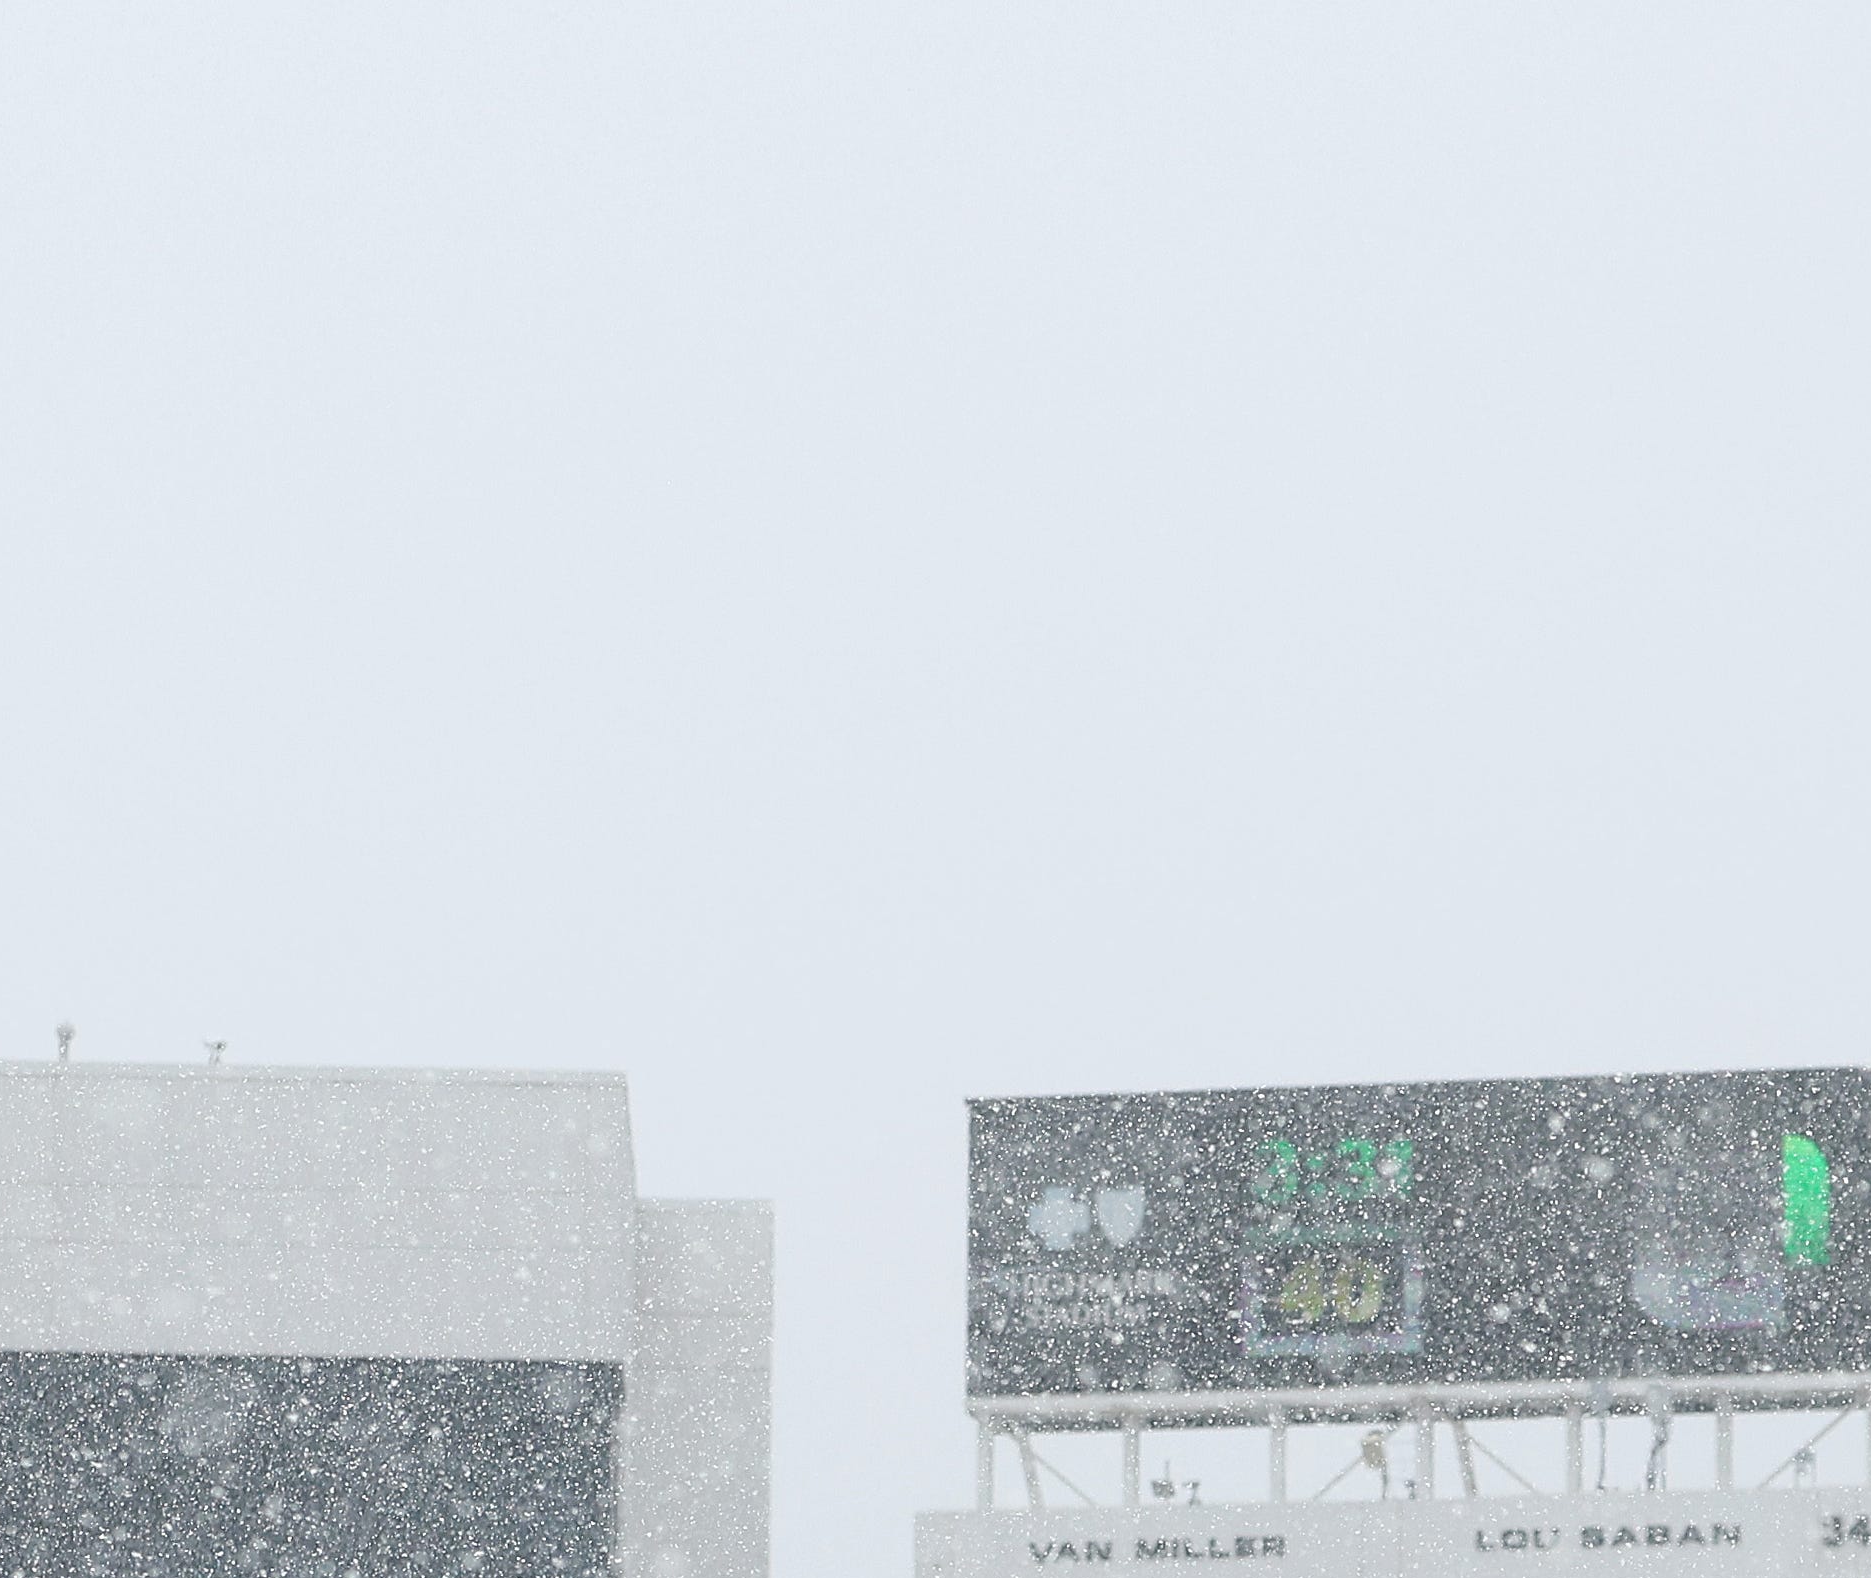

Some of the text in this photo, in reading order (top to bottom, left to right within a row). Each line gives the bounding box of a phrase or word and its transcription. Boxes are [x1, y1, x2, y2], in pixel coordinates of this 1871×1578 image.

[1028, 1535, 1287, 1562] VAN MILLER
[1475, 1522, 1743, 1551] LOU SABAN
